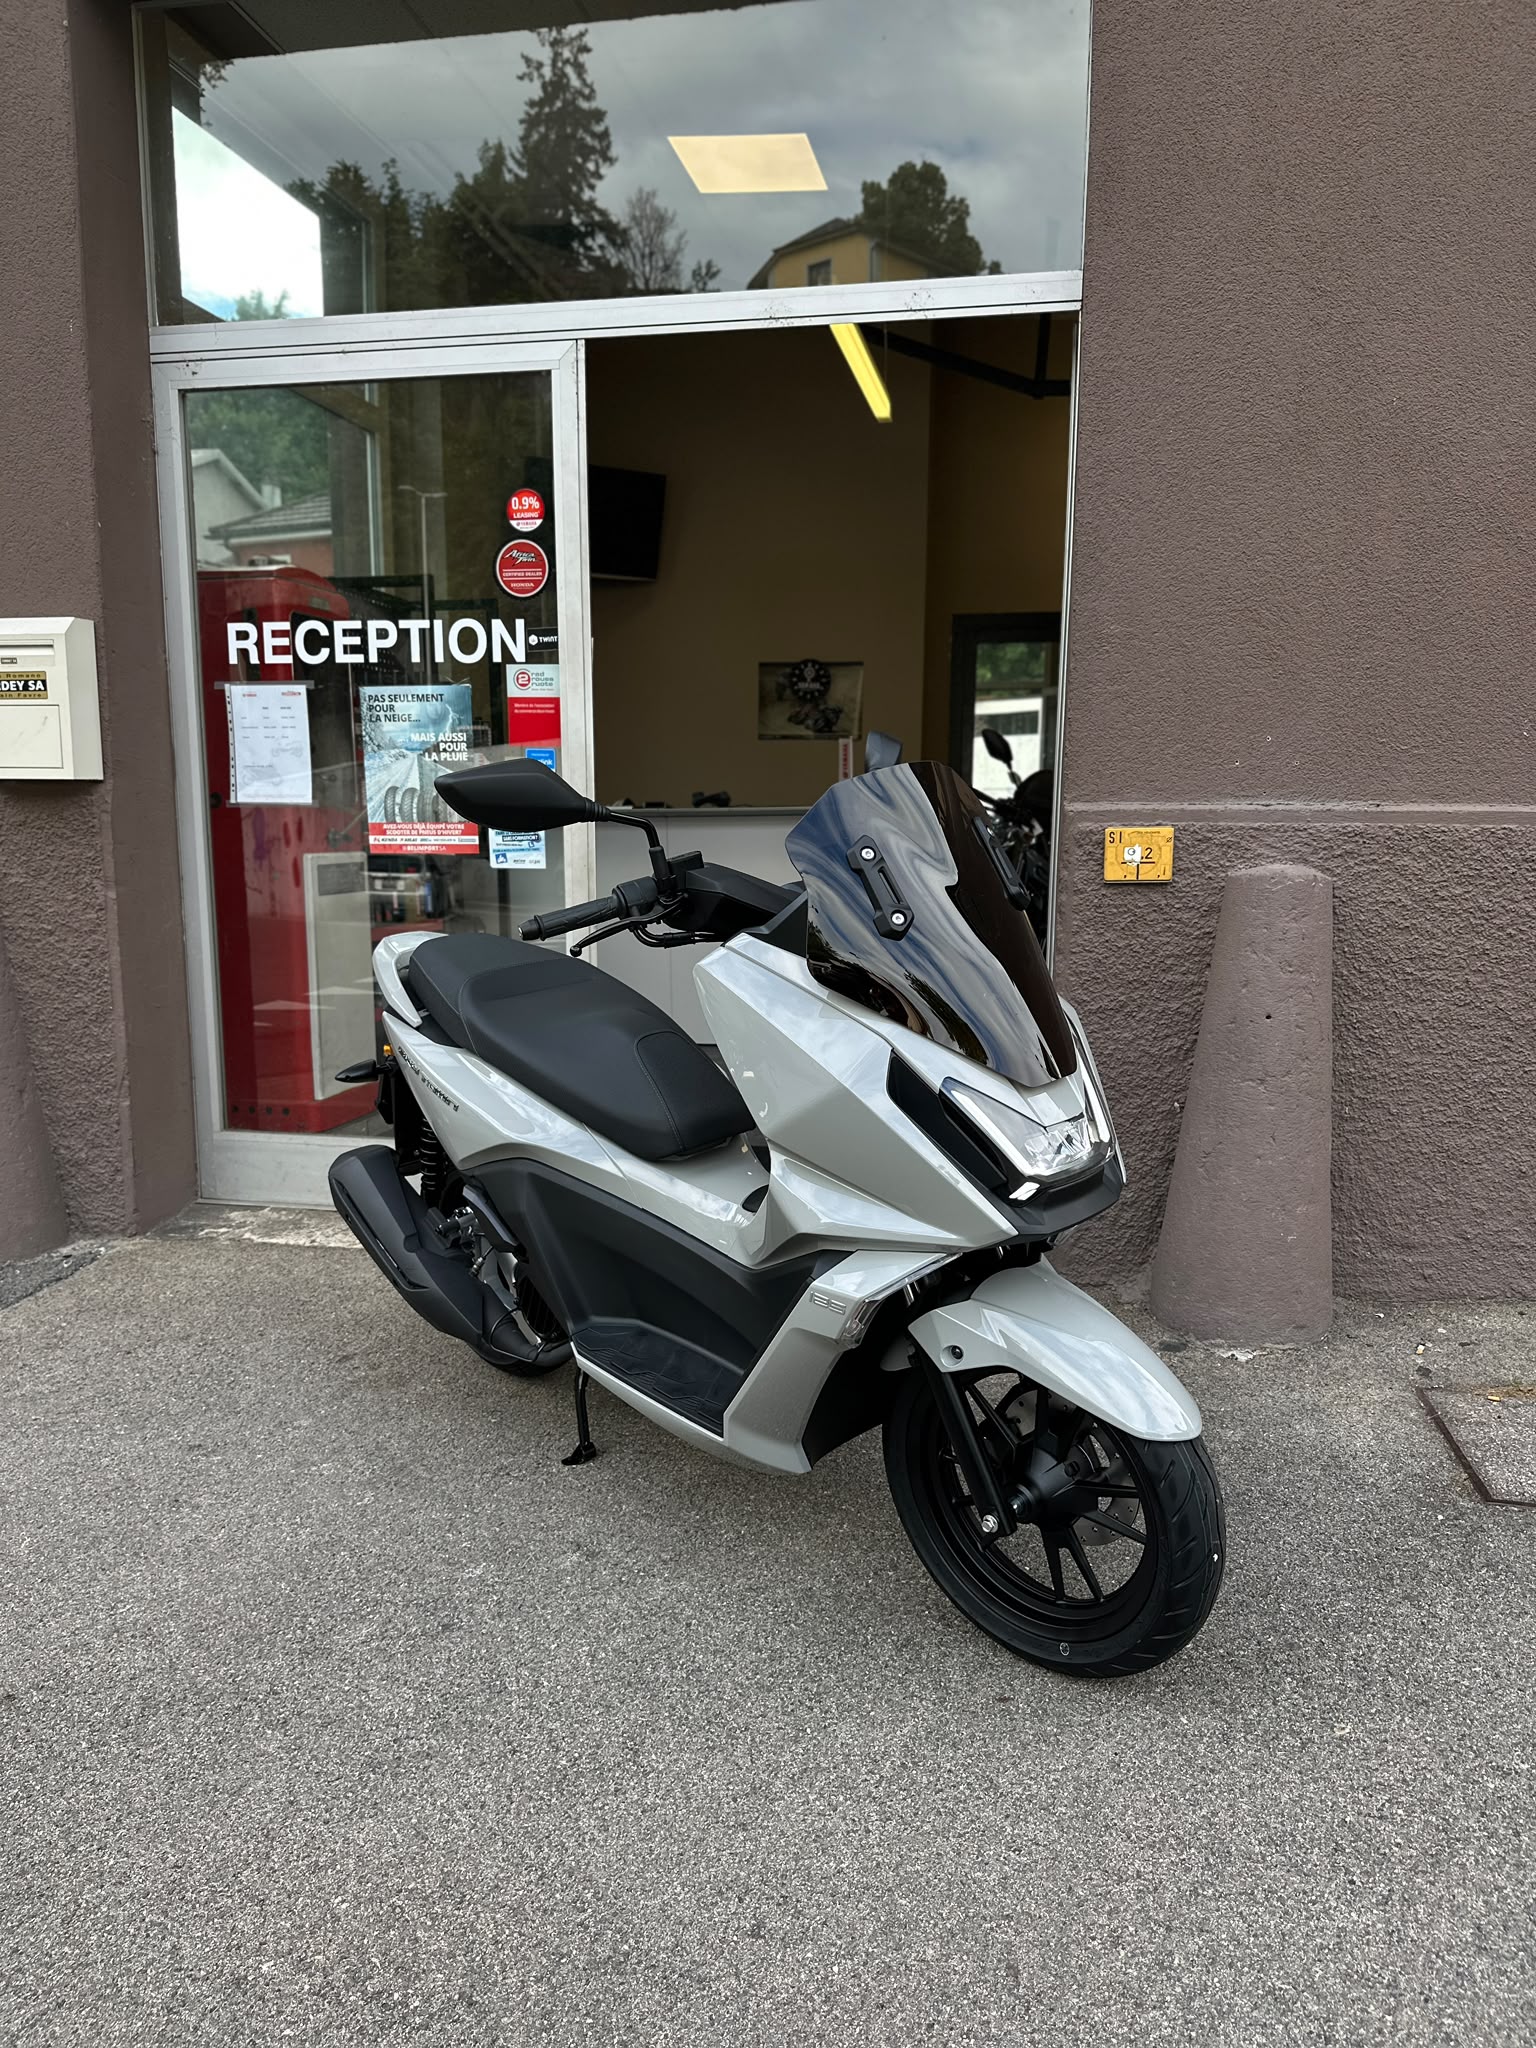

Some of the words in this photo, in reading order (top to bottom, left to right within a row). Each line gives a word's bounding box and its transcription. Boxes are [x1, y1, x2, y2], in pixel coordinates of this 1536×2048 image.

[511, 496, 539, 510] 0.9%
[226, 617, 526, 665] RECEPTION
[538, 635, 558, 643] TWINT
[0, 680, 24, 691] DEY
[28, 680, 45, 691] SA
[367, 694, 386, 703] PAS
[388, 693, 445, 703] SEULEMENT
[368, 704, 396, 713] POUR
[369, 714, 382, 723] LA
[410, 733, 436, 742] MAIS
[438, 732, 467, 742] AUSSI
[439, 742, 468, 752] POUR
[424, 752, 439, 761] LA
[440, 752, 468, 761] PLUIE
[809, 1291, 847, 1315] 125
